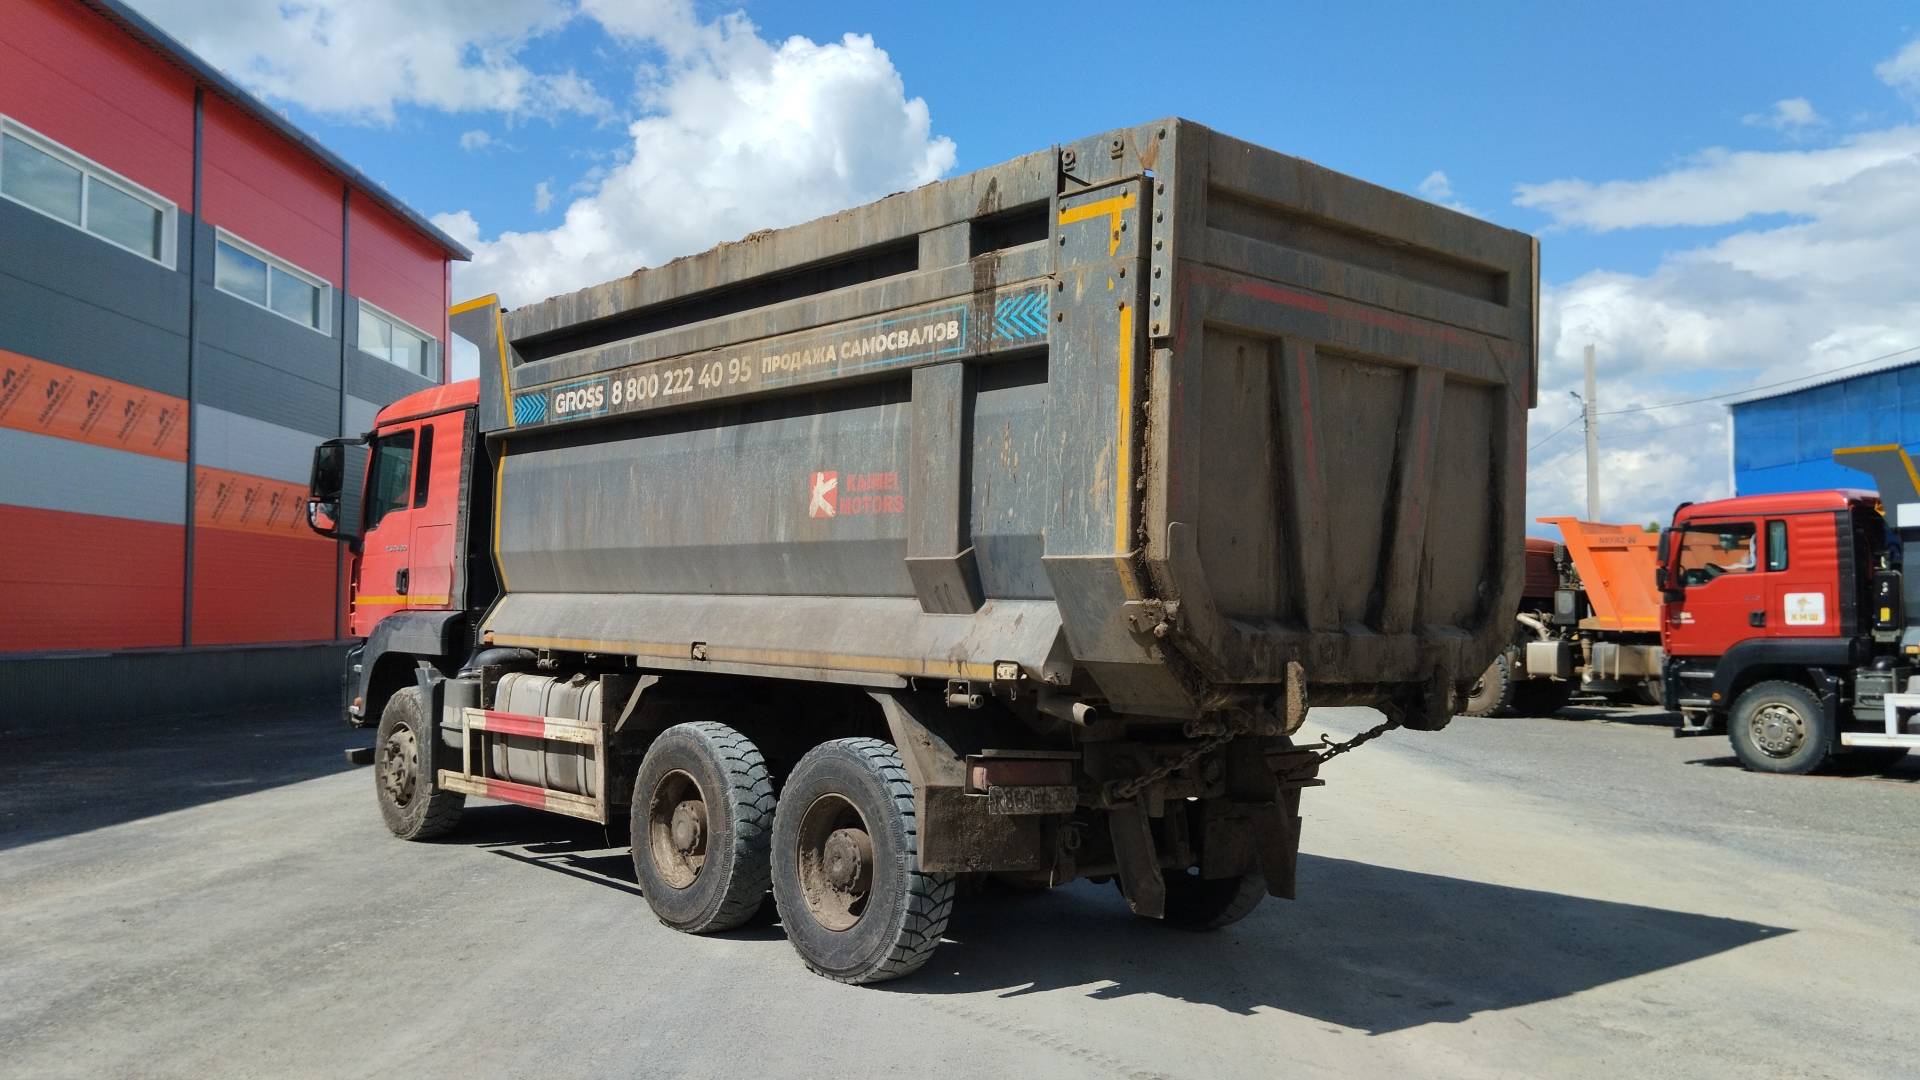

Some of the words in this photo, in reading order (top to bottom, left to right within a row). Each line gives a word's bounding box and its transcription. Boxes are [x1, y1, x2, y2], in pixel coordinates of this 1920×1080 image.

[761, 344, 837, 374] ПРОДАЖА
[840, 320, 959, 359] САМОСВАЛОВ
[555, 384, 604, 414] GROSS
[611, 382, 623, 405] 8
[625, 374, 659, 402] 800
[663, 367, 694, 396] 222
[698, 361, 724, 389] 40
[728, 357, 751, 385] 95
[839, 495, 905, 515] MOTORS
